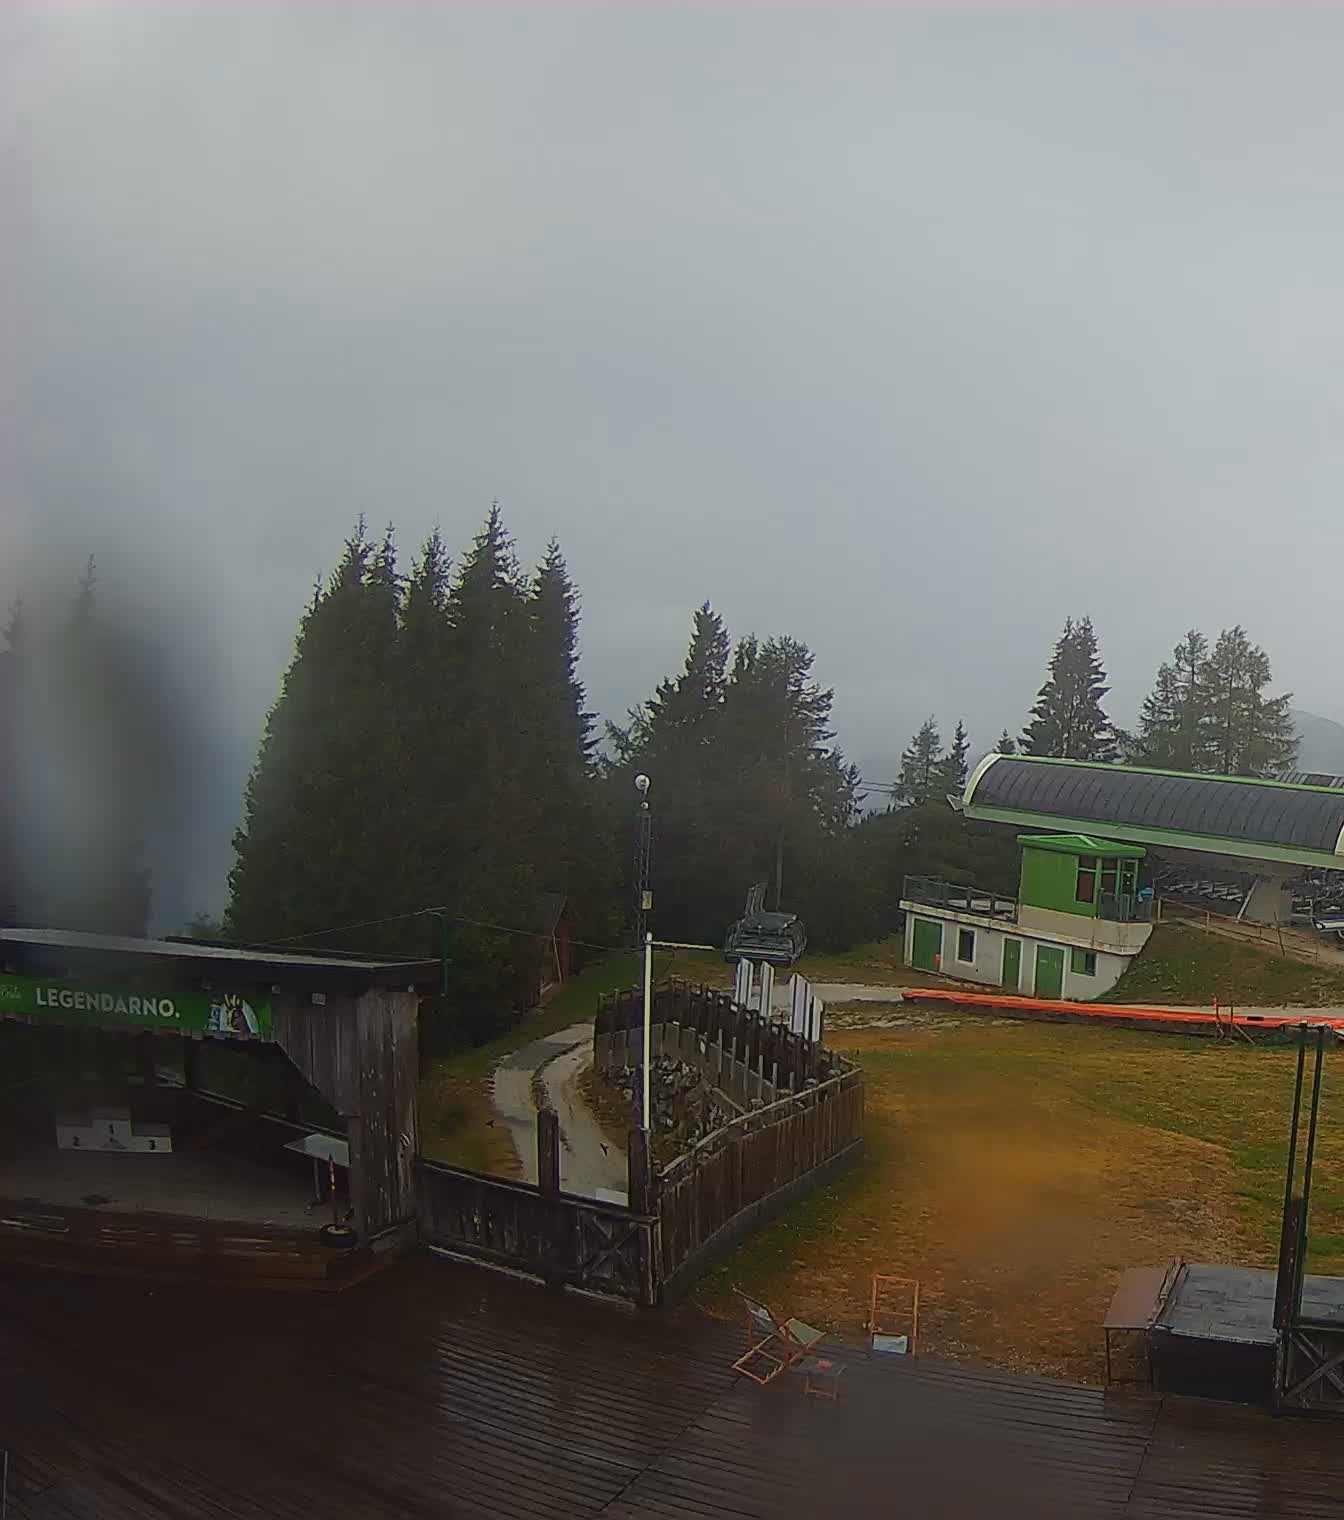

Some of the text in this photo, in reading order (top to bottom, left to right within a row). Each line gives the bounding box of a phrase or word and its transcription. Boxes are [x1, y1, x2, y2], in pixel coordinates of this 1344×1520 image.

[35, 987, 181, 1019] LEGENDARNO.
[71, 1135, 81, 1147] 2
[147, 1139, 157, 1150] 3
